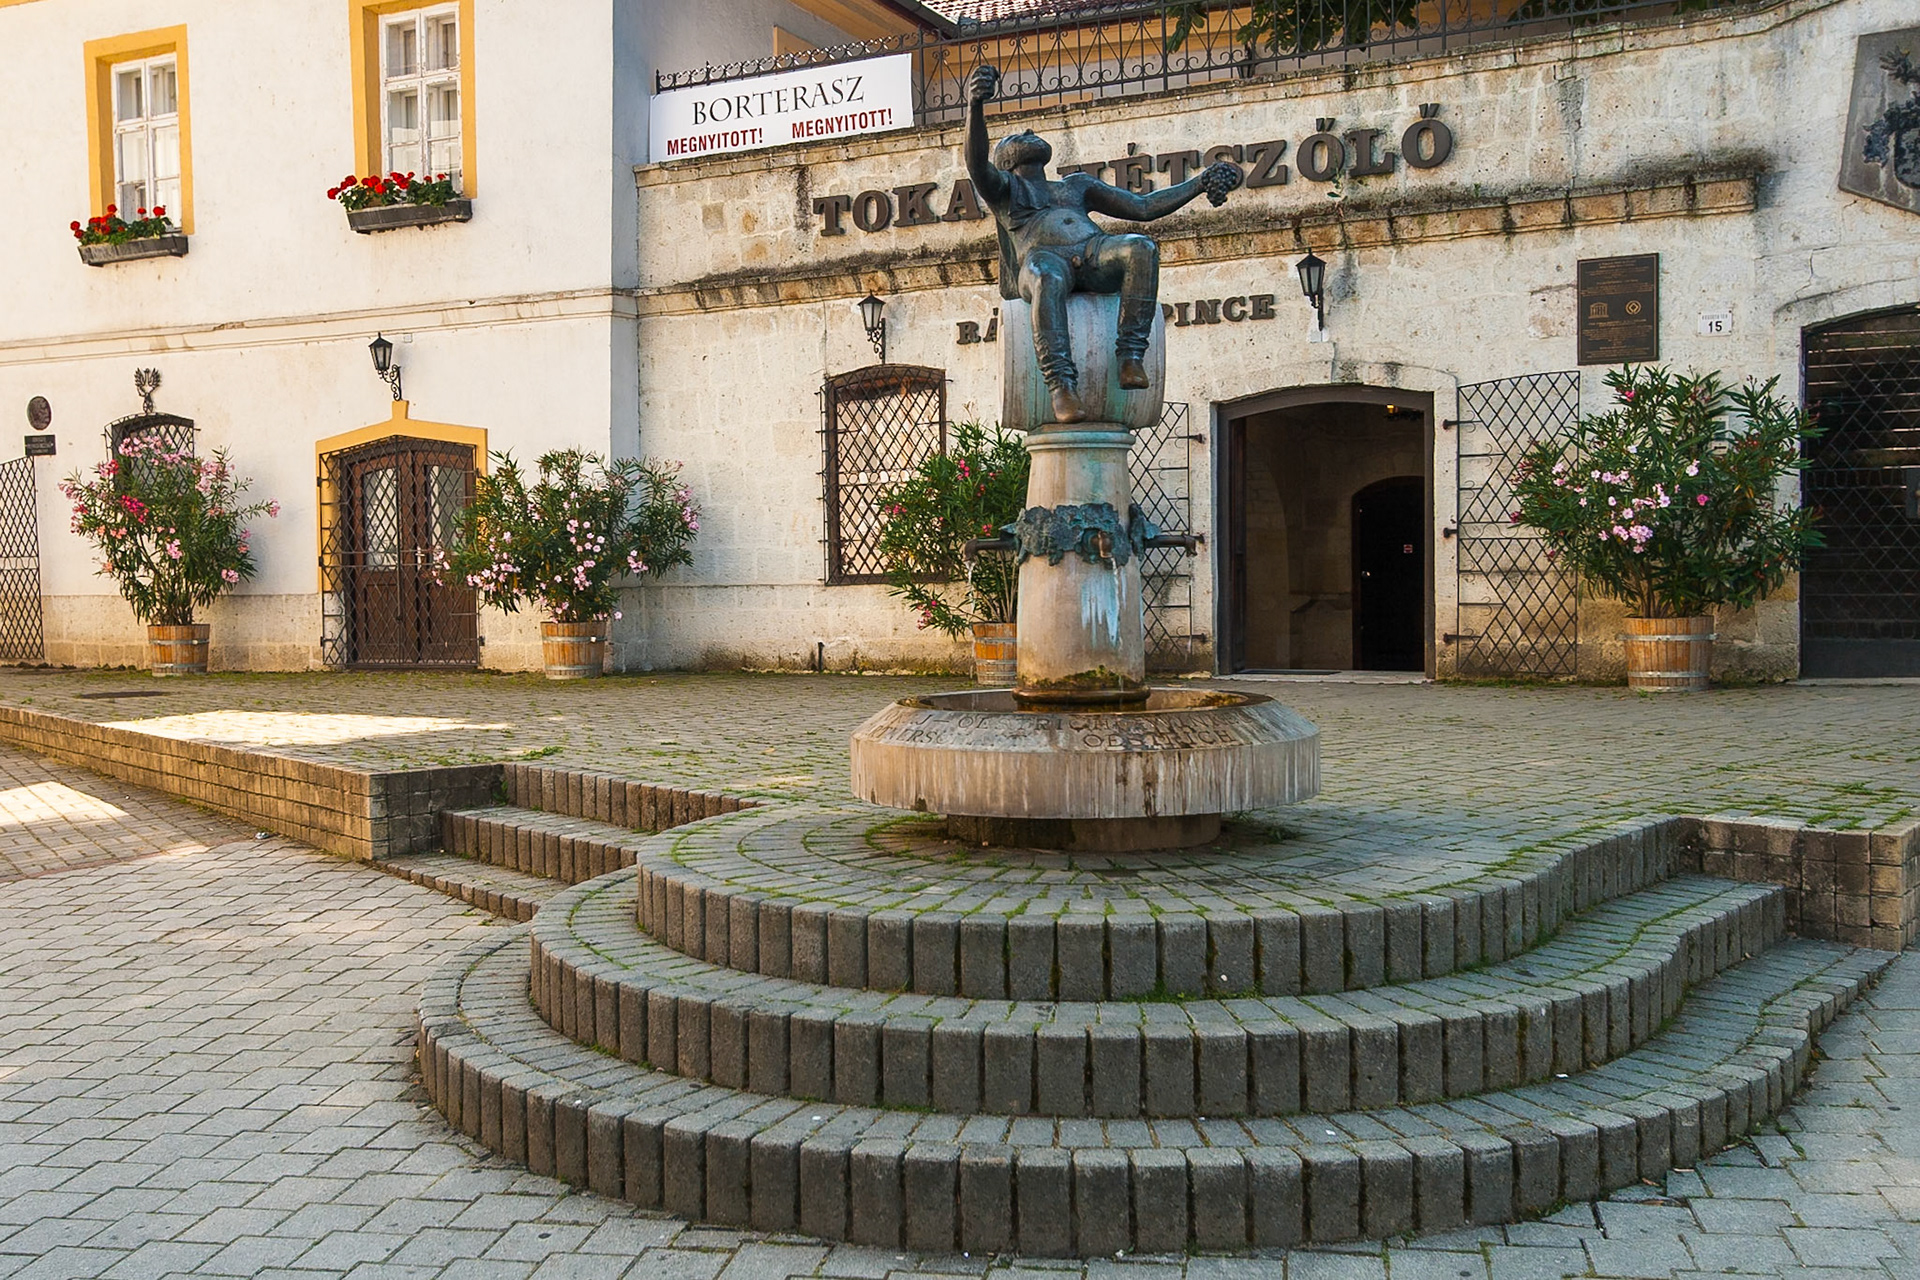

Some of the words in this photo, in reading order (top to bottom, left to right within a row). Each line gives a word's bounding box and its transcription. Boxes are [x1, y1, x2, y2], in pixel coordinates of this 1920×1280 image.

[692, 75, 866, 126] BORTERASZ
[667, 128, 764, 156] MEGNYITOTT!
[792, 108, 893, 139] MEGNYITOTT!
[813, 178, 986, 237] TOKA
[1057, 102, 1453, 197] ÉTSZŐLŐ
[1709, 320, 1723, 333] 15
